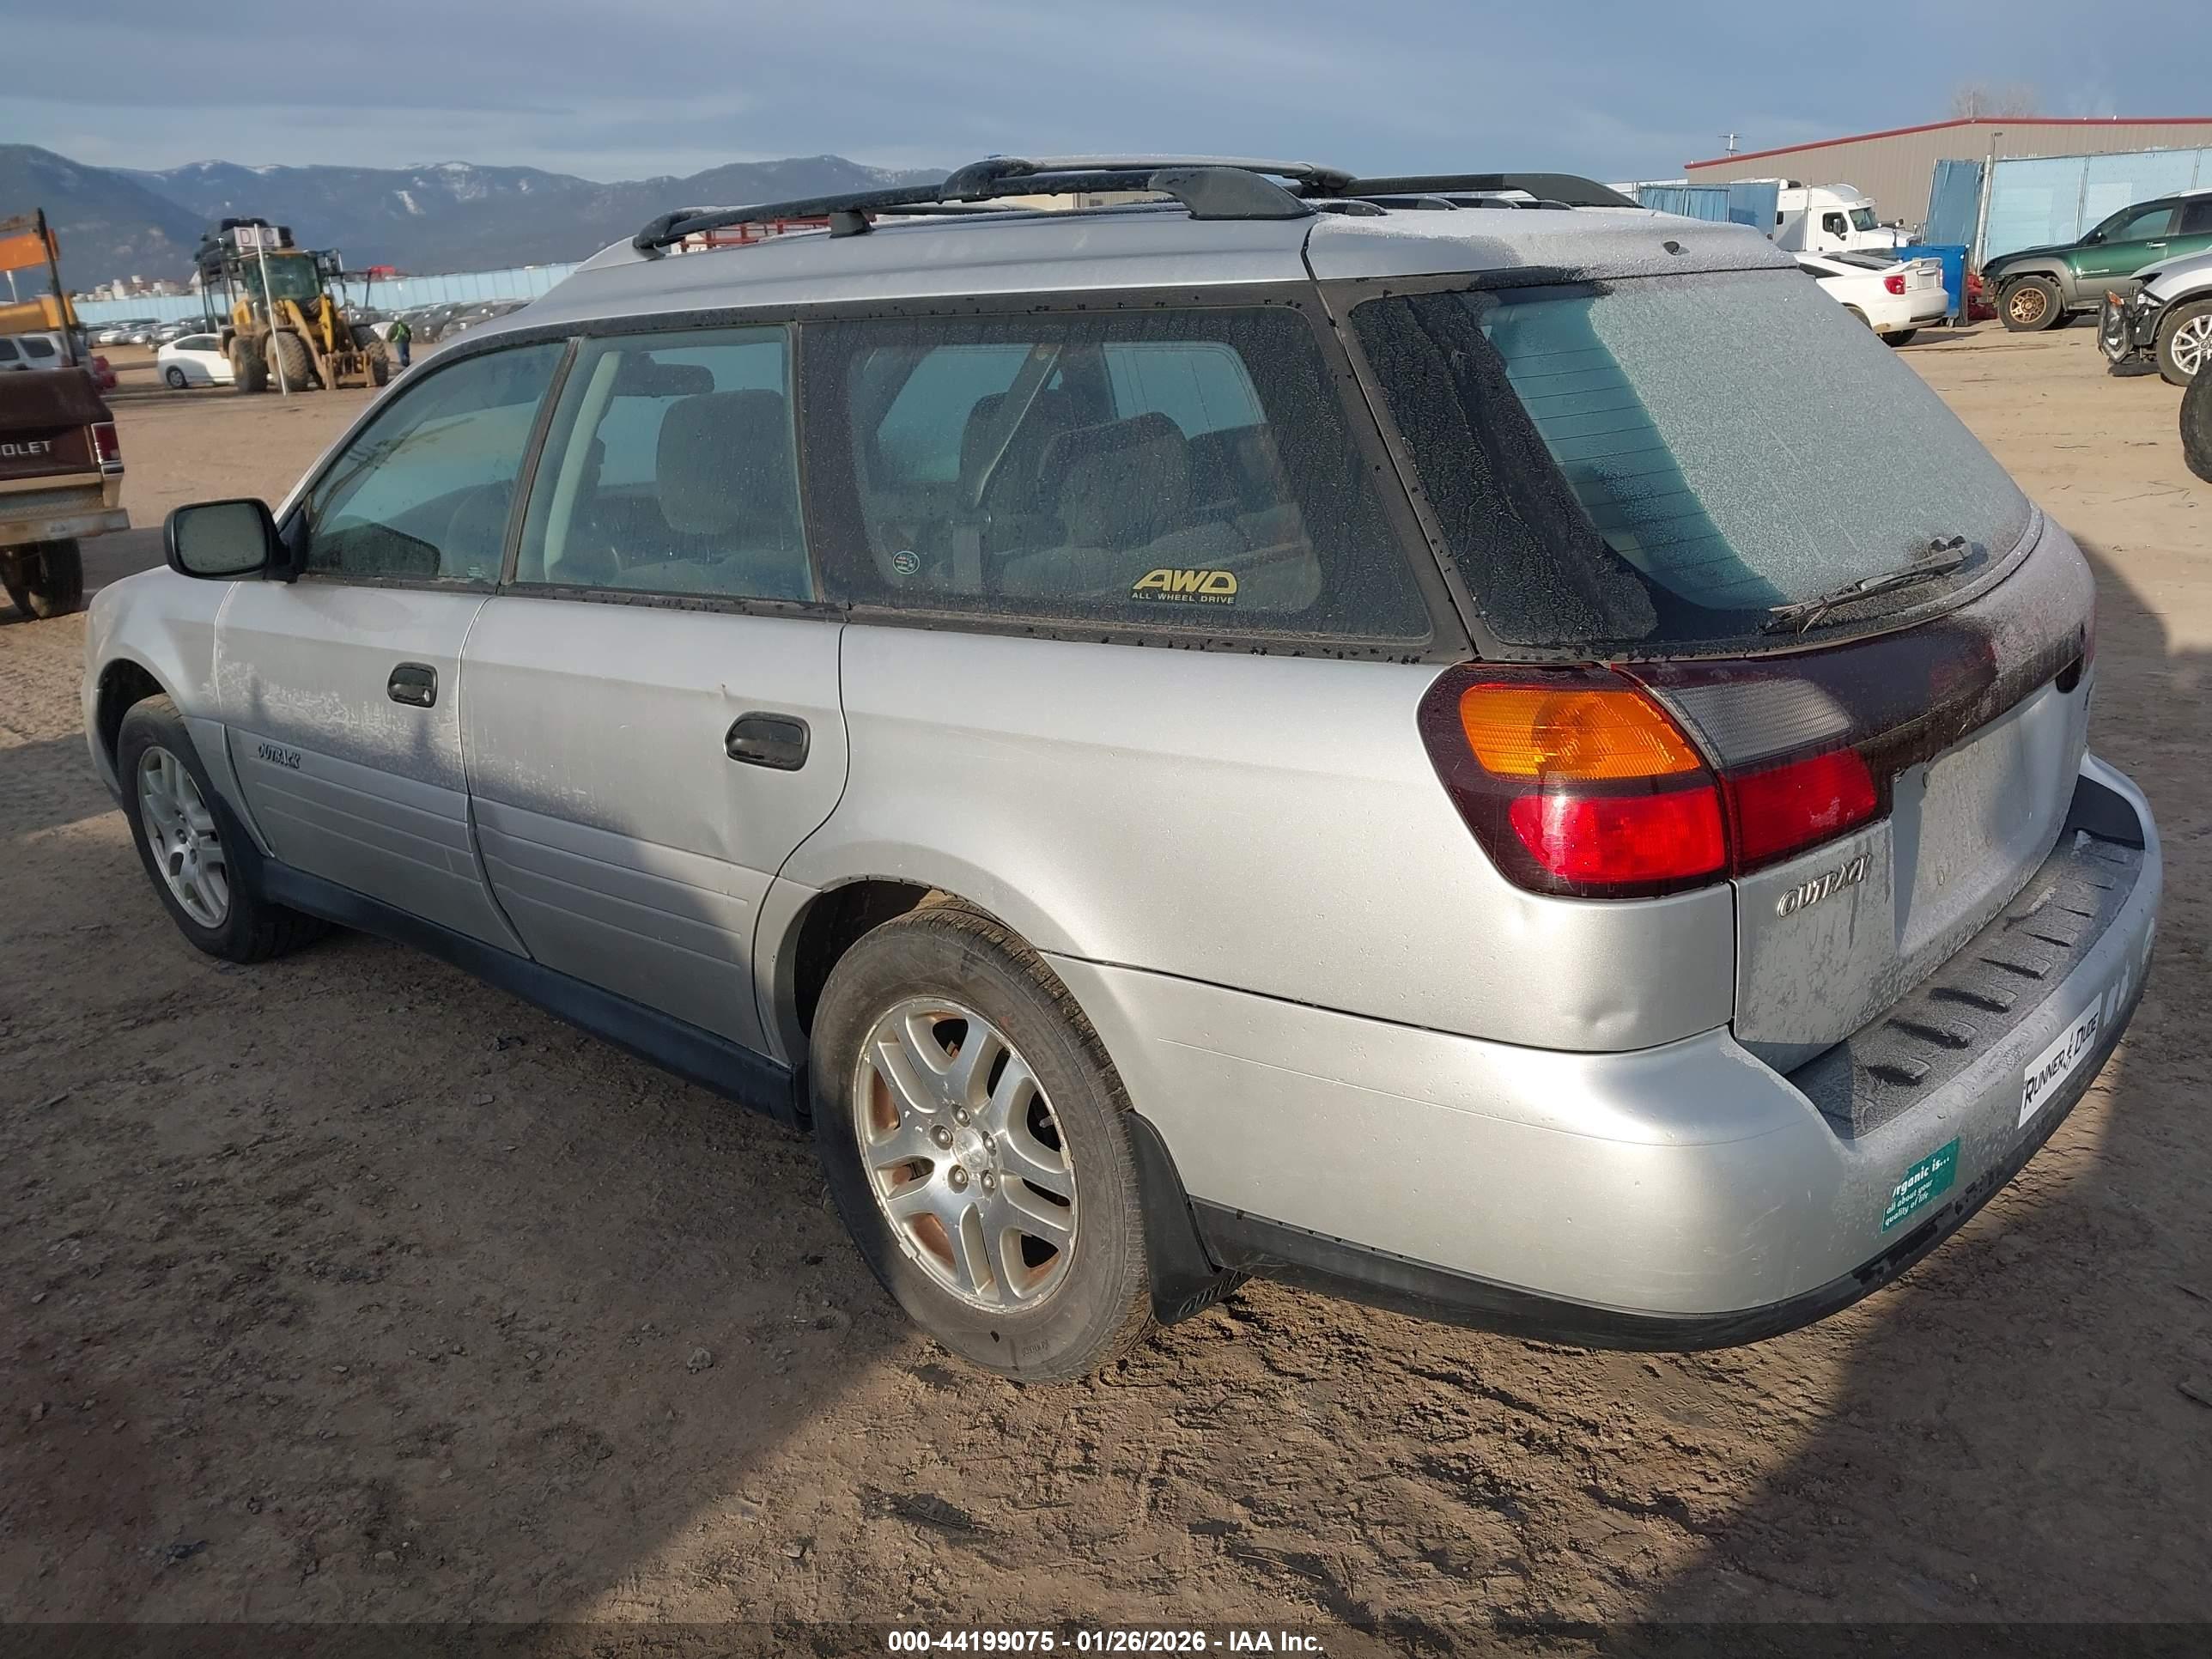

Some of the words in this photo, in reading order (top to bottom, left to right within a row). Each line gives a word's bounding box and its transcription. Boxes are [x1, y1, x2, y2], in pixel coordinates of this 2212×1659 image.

[240, 228, 252, 245] D
[264, 228, 276, 245] C
[0, 441, 52, 456] OLET
[1133, 568, 1238, 594] AWD
[1158, 593, 1195, 602] WHEEL
[1200, 595, 1235, 605] DRIVE
[258, 742, 301, 769] OUTBACK
[2024, 1049, 2065, 1109] RUNNER
[1886, 1200, 1896, 1215] all
[1897, 1188, 1917, 1207] about
[1917, 1179, 1933, 1196] your
[1885, 1206, 1910, 1226] quality
[1910, 1196, 1918, 1209] of
